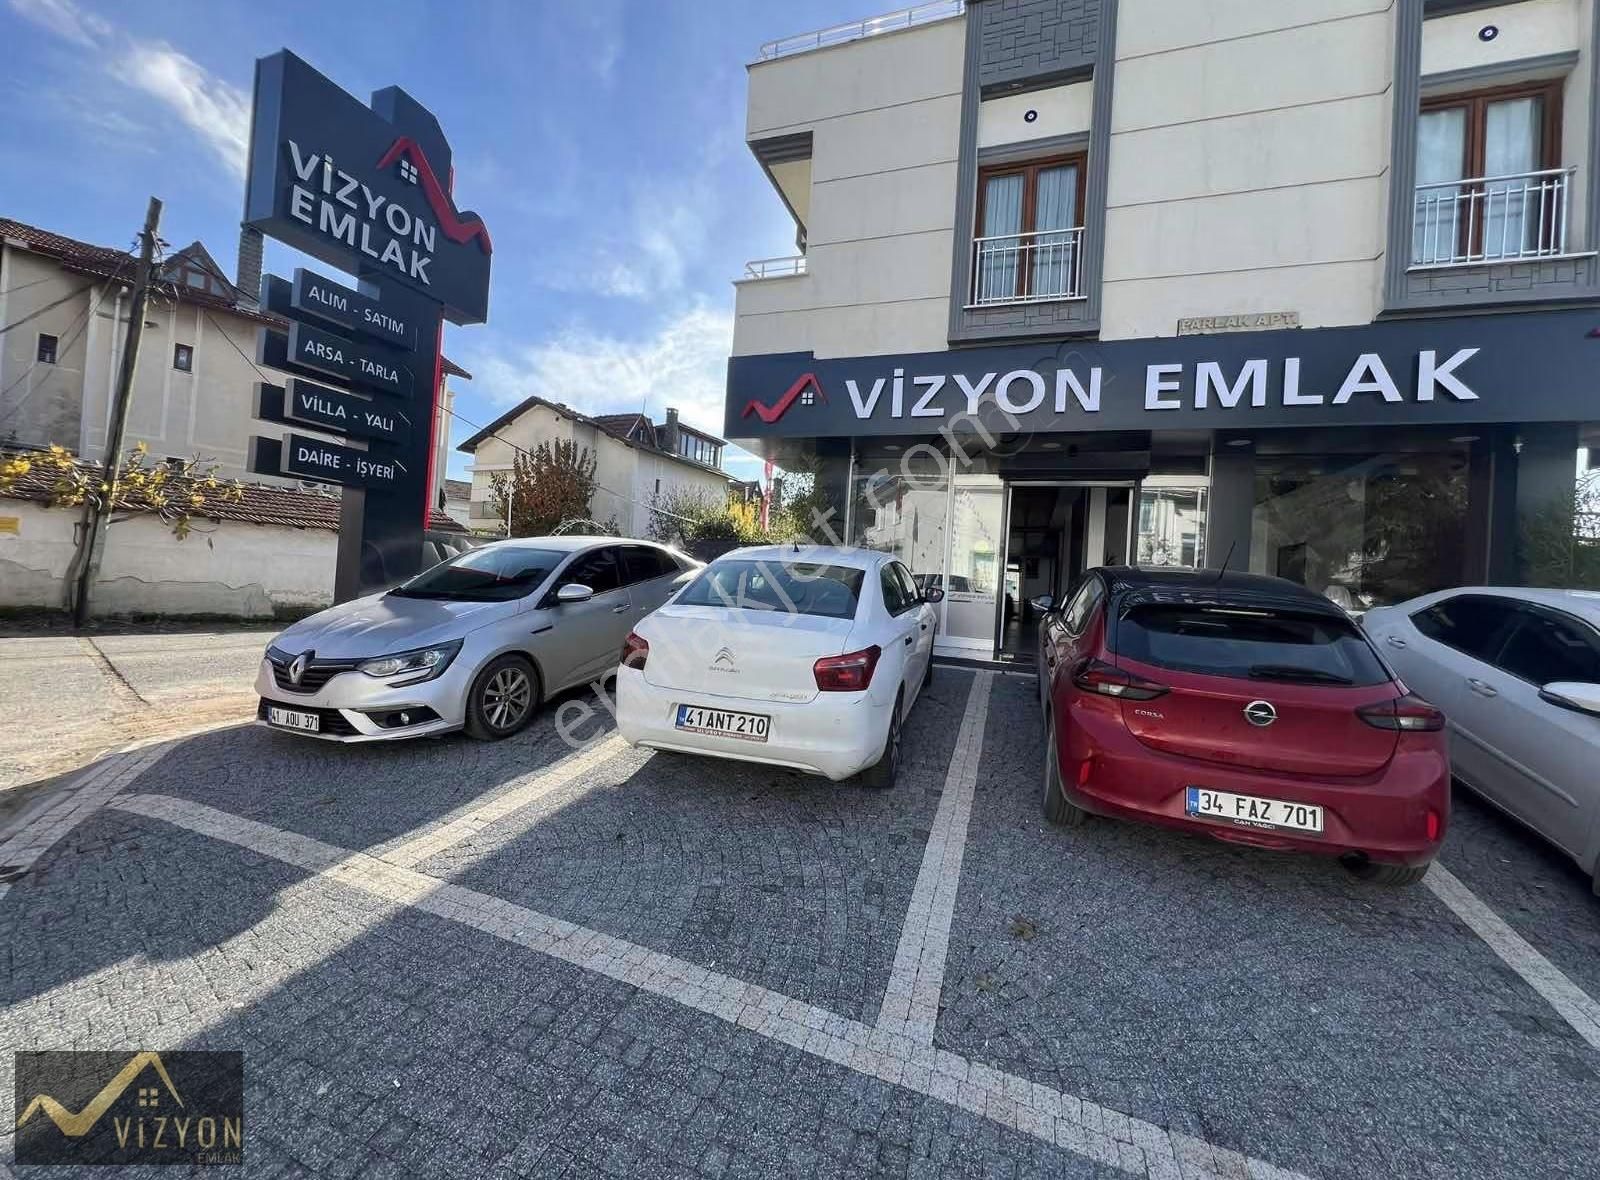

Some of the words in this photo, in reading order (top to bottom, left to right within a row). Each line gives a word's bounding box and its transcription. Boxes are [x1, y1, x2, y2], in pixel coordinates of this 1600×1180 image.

[288, 139, 436, 253] VİZYON
[291, 184, 432, 285] EMLAK
[308, 286, 347, 312] ALIM
[364, 308, 404, 335] SATIM
[1181, 314, 1249, 330] PARLAK
[304, 340, 344, 364] ARSA
[360, 358, 399, 384] TARLA
[845, 367, 1102, 419] VİZYON
[1144, 347, 1481, 410] EMLAK
[302, 394, 346, 419] VİLLA
[365, 412, 394, 432] YALI
[298, 448, 341, 469] DAİRE
[356, 458, 395, 480] İŞYERİ
[304, 714, 318, 730] 371
[685, 709, 703, 726] 41
[706, 712, 735, 731] ANT
[736, 716, 766, 735] 210
[1135, 709, 1164, 719] CORSA
[1201, 792, 1223, 813] 34
[1235, 797, 1271, 821] FAZ
[1283, 804, 1317, 829] 701
